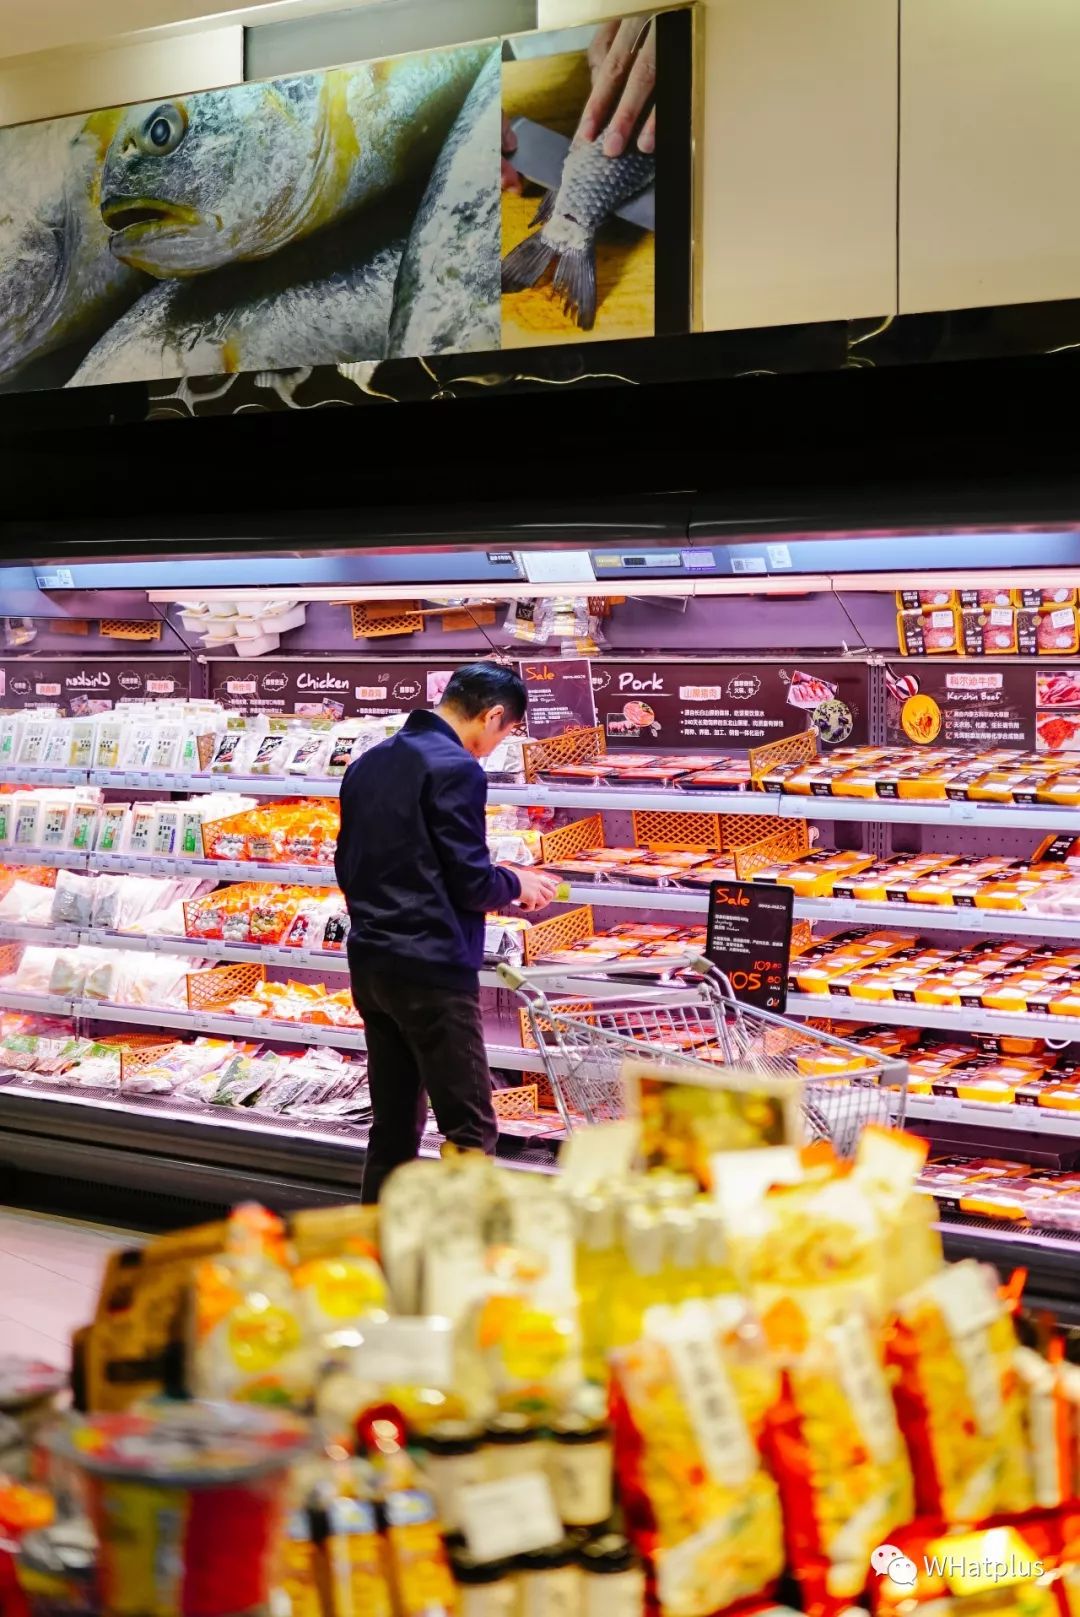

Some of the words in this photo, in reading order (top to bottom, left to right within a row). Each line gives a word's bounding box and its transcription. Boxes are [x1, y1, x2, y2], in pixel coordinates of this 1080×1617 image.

[296, 672, 350, 690] Chicken
[526, 664, 556, 681] Sale
[618, 671, 665, 692] Pork
[980, 691, 1003, 701] Beef
[715, 887, 751, 907] Sale
